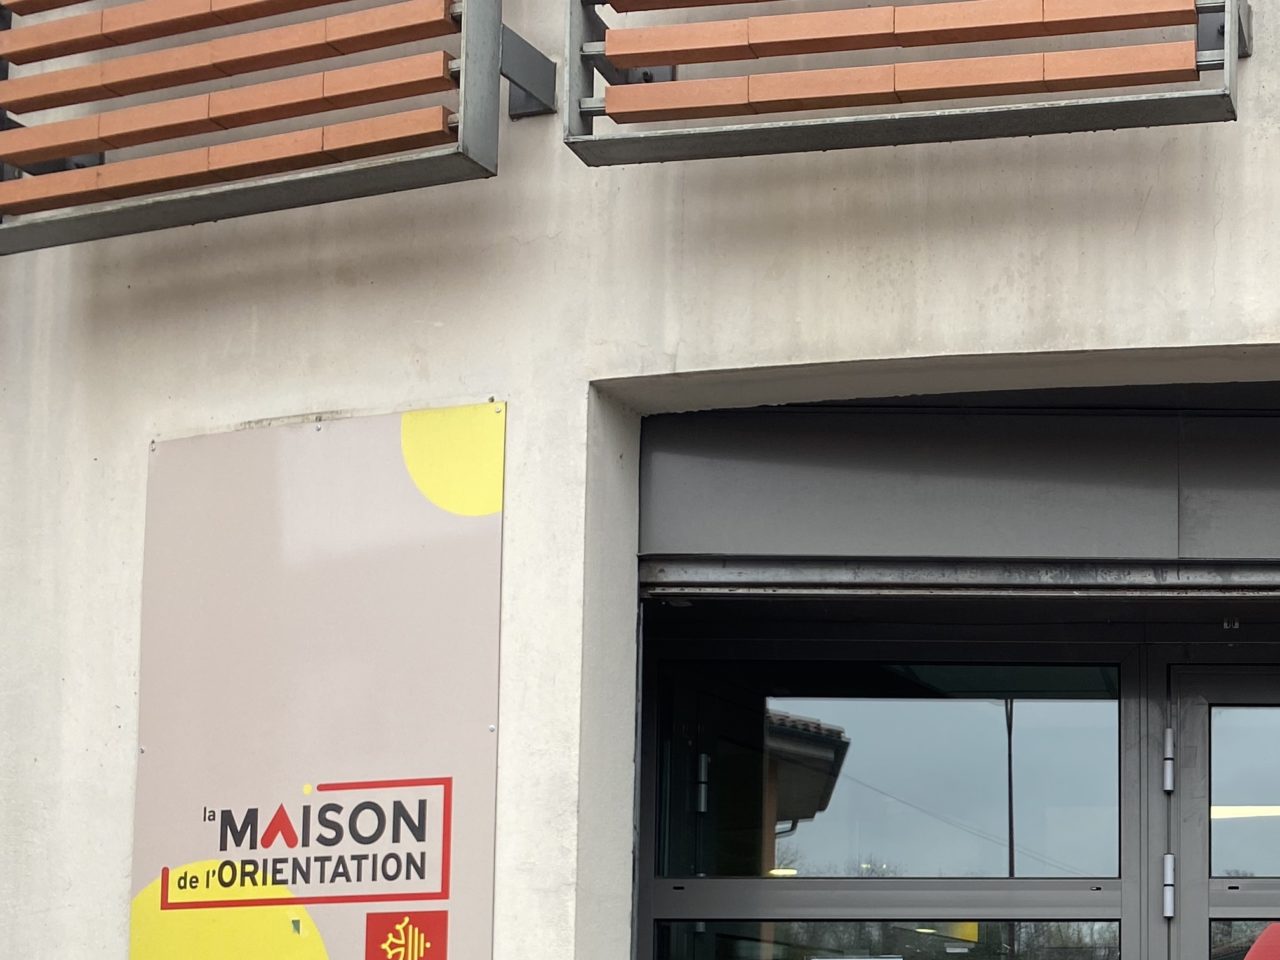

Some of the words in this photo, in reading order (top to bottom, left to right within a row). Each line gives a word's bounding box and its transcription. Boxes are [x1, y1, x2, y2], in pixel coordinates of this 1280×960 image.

[203, 807, 216, 822] la
[217, 799, 428, 851] MAISON
[177, 871, 199, 890] de
[205, 852, 427, 889] l'ORIENTATION
